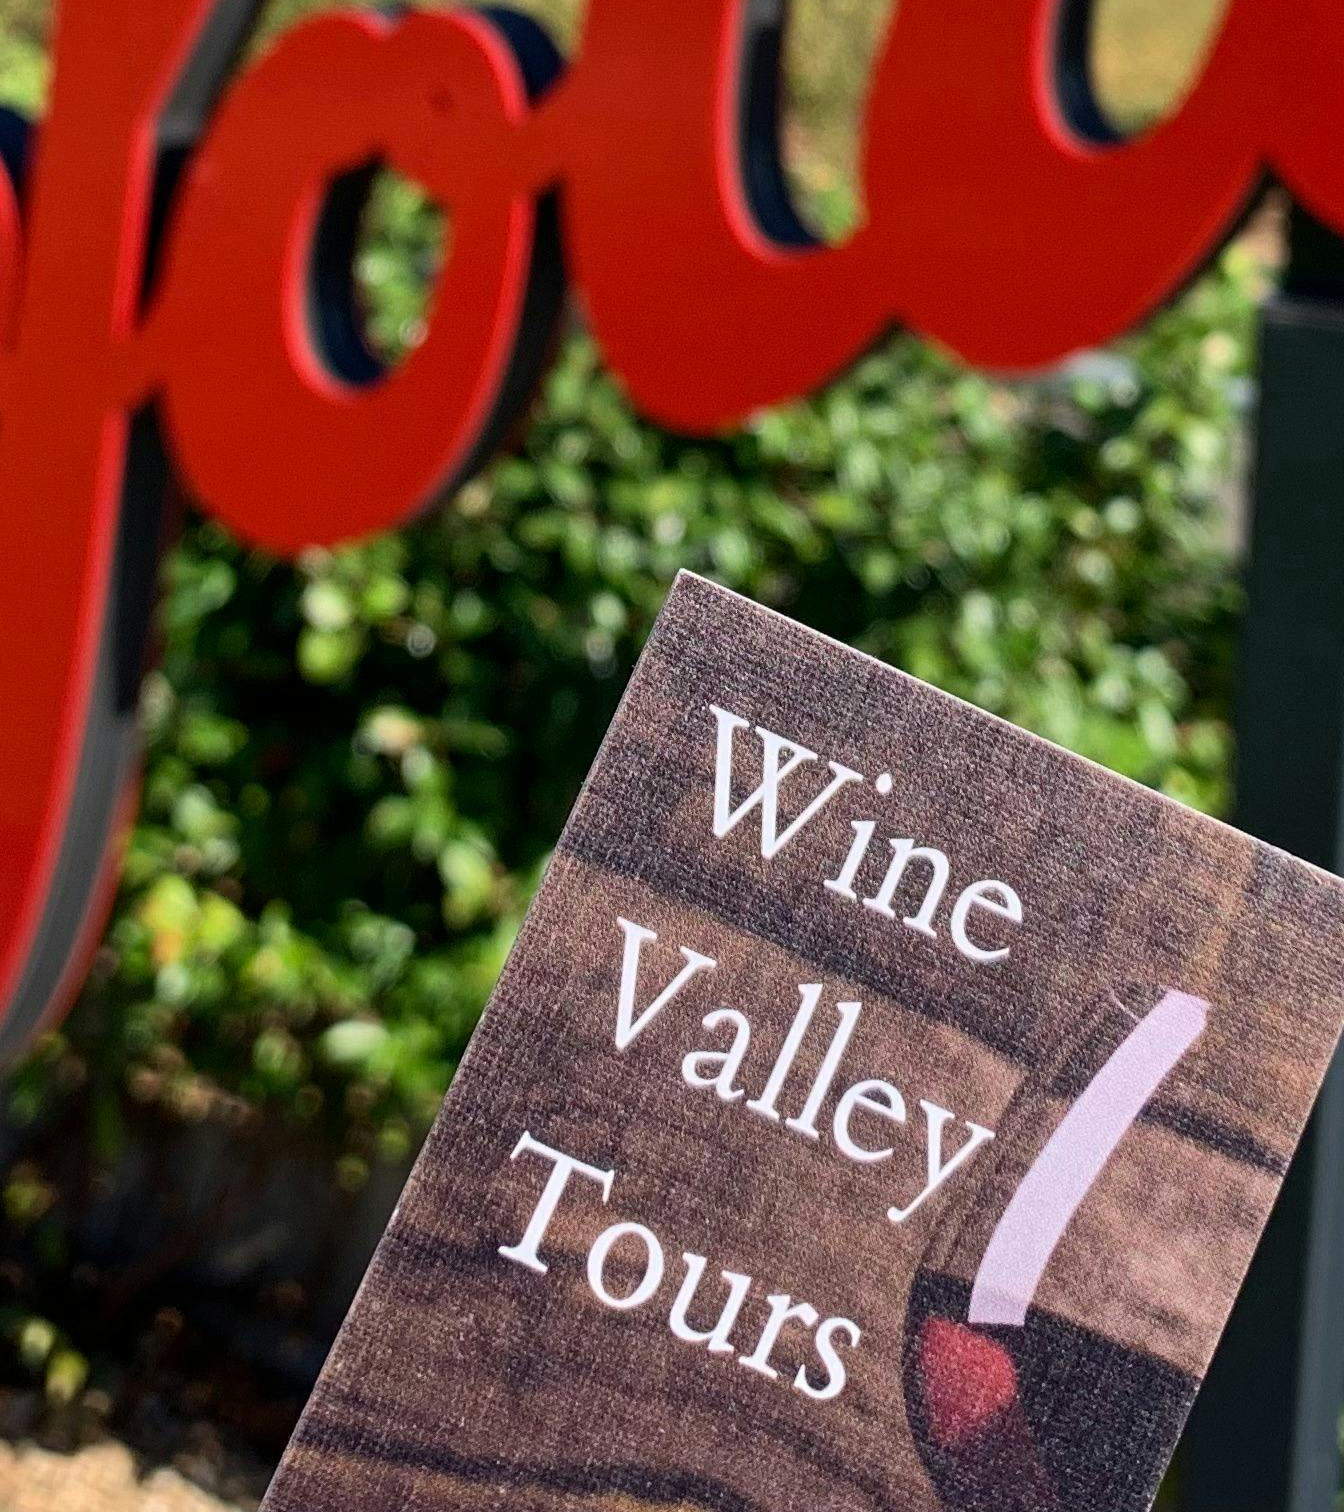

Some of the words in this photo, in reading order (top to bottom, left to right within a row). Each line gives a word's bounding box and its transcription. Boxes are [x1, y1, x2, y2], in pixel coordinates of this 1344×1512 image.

[708, 705, 1024, 962] Wine
[615, 918, 995, 1222] Valley
[498, 1133, 861, 1399] Tours
